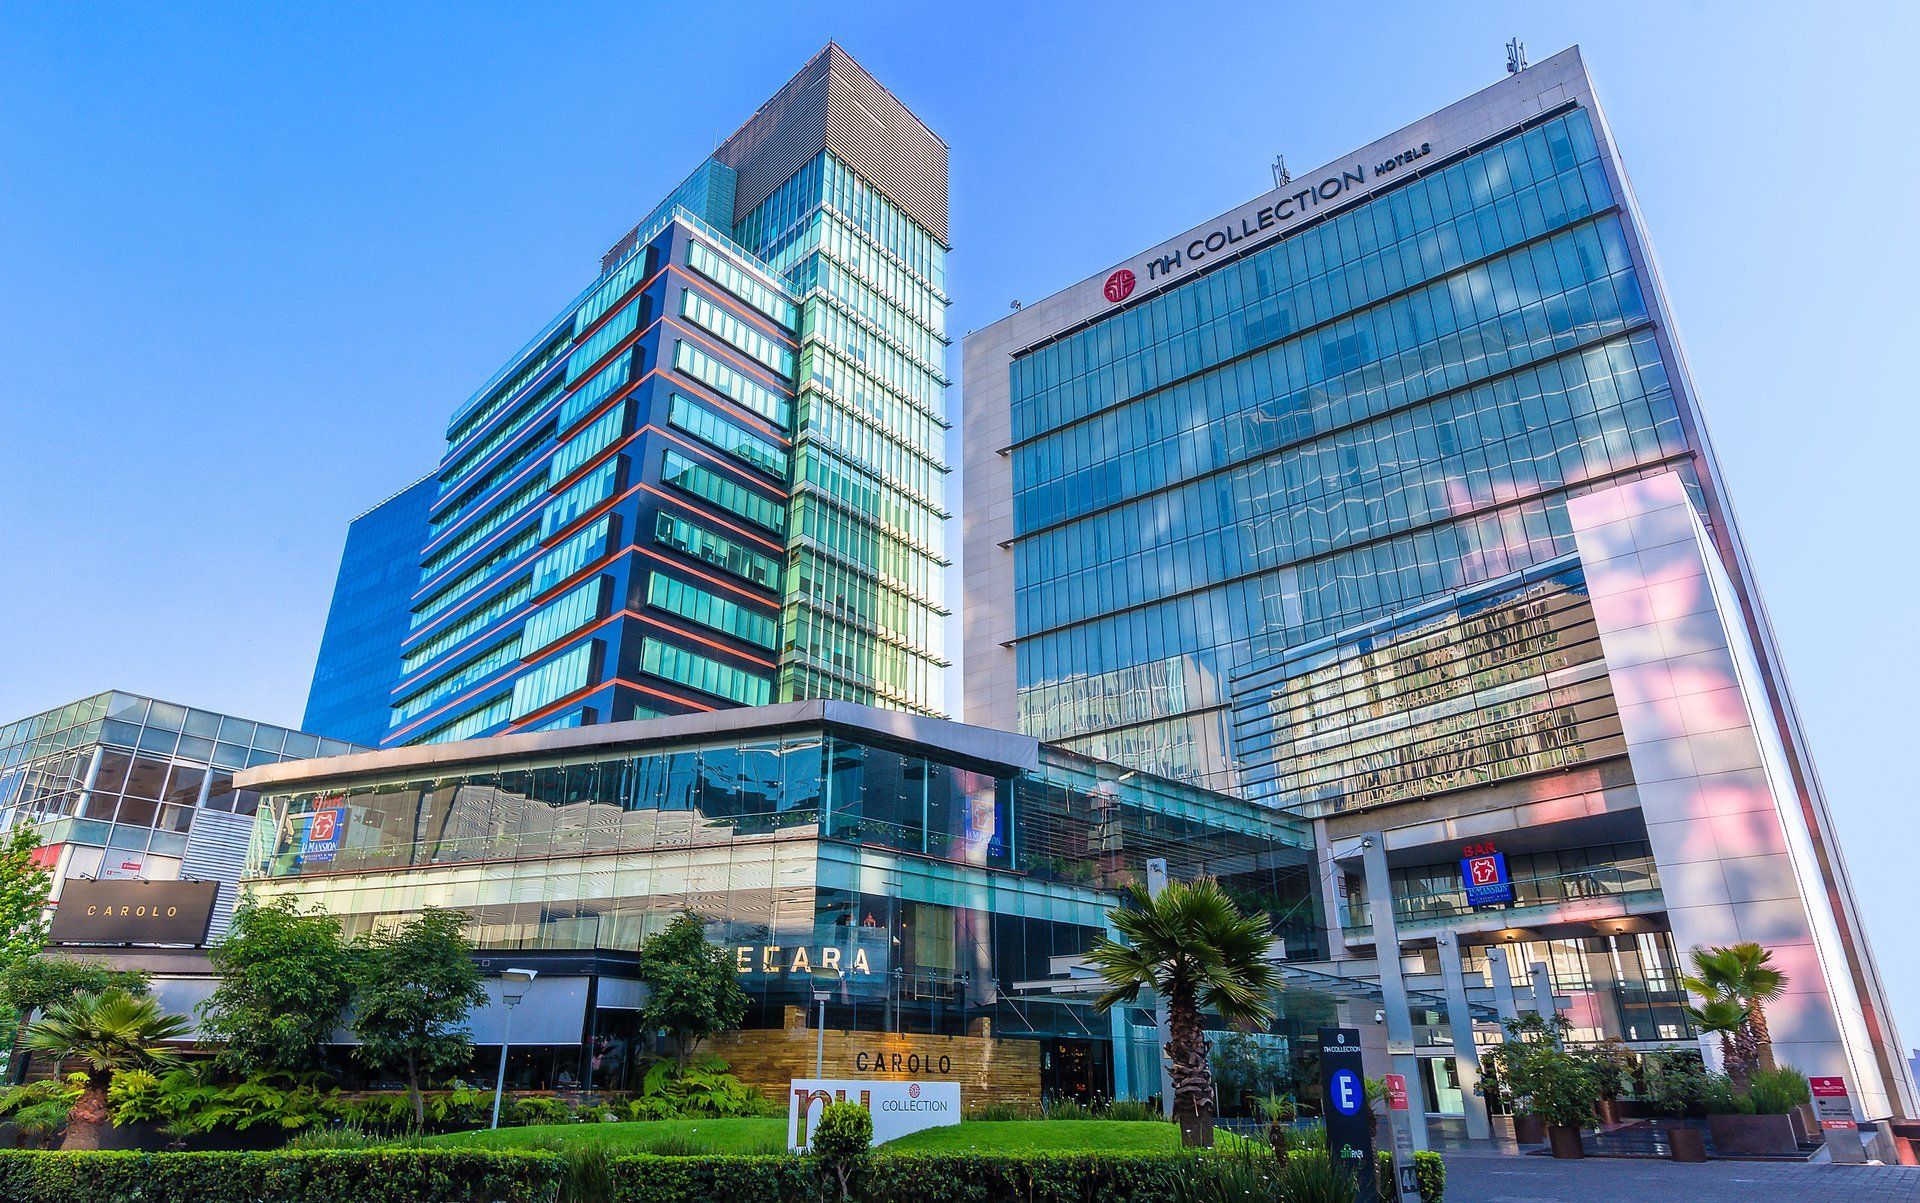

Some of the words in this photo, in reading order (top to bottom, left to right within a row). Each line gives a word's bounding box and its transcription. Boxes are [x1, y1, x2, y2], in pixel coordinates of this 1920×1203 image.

[1187, 164, 1365, 261] COLLECTION
[1374, 142, 1431, 177] HOTELS
[308, 841, 337, 852] MANSION
[1462, 840, 1496, 857] BAR
[87, 905, 178, 917] CAROLO
[1331, 1045, 1360, 1053] COLLECTION
[856, 1051, 951, 1075] CAROLO
[1339, 1076, 1354, 1109] E
[881, 1100, 948, 1112] COLLECTION
